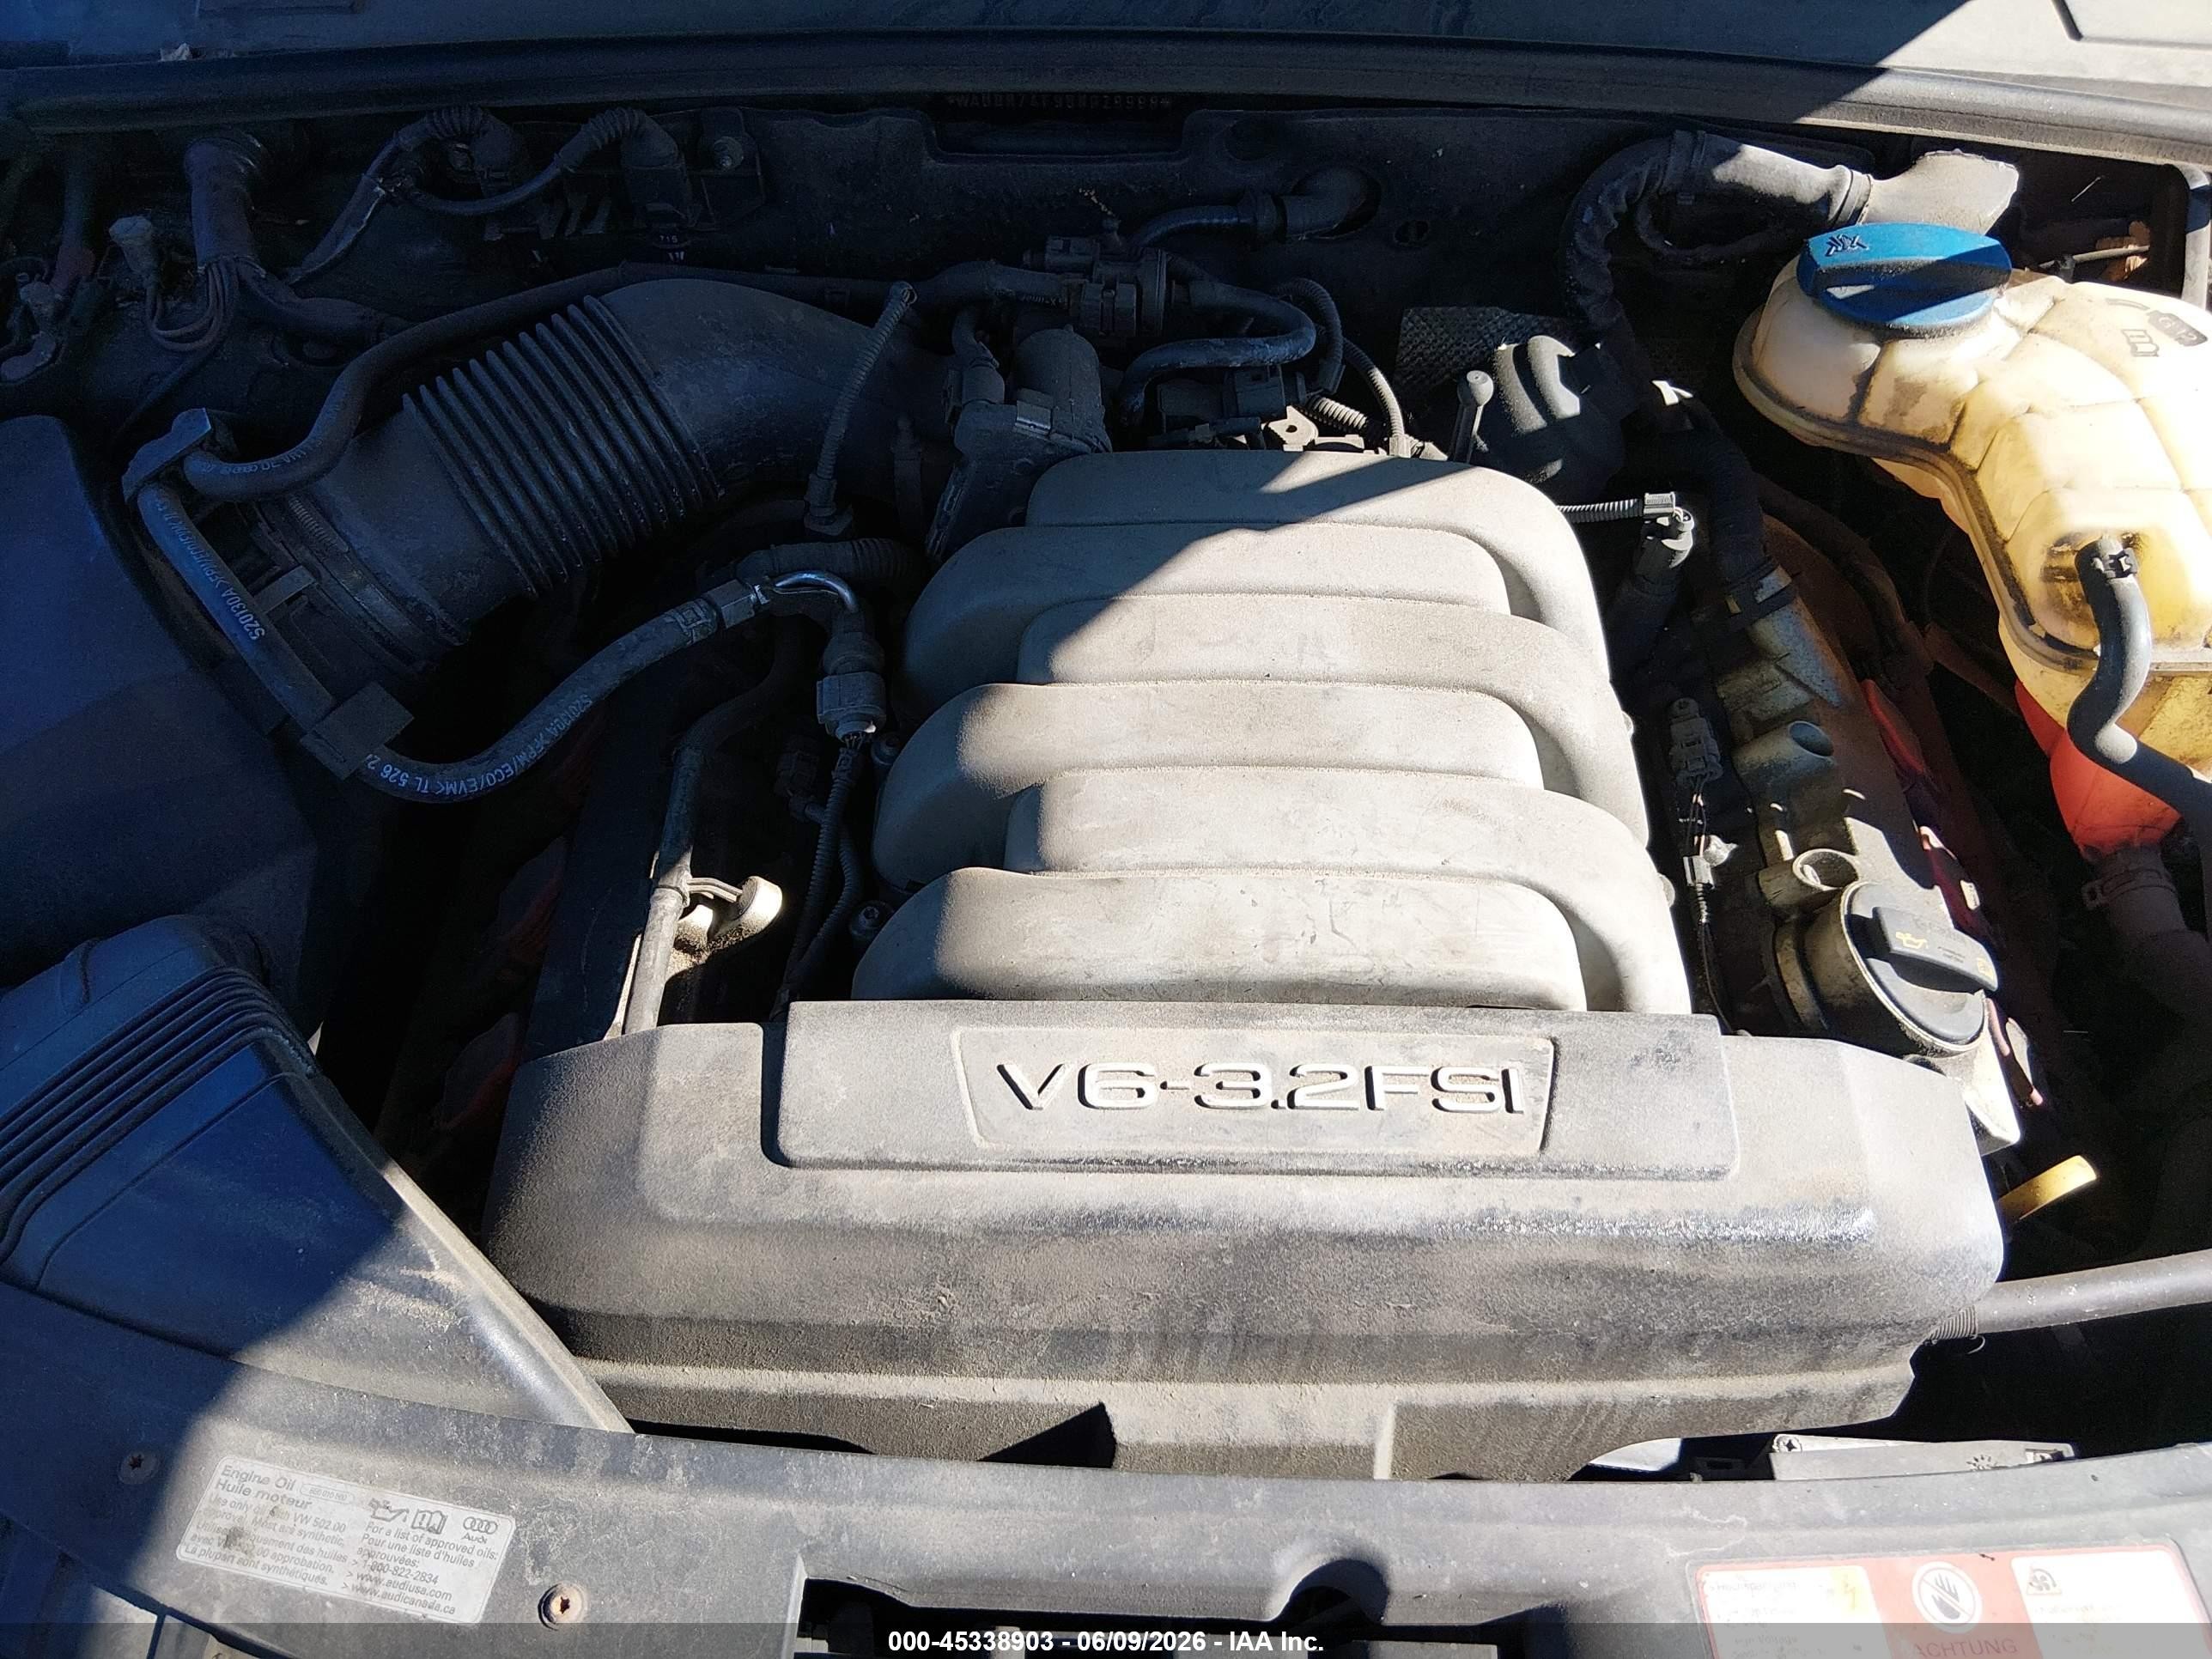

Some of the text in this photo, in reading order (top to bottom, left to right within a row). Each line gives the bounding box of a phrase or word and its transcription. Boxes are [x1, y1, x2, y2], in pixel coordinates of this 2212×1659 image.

[222, 587, 265, 641] S20130A
[380, 763, 410, 787] 526
[415, 775, 430, 793] TL
[221, 1465, 270, 1486] Engine
[274, 1476, 296, 1491] Oil
[216, 1479, 313, 1510] Huile moteur
[210, 1492, 228, 1506] Use
[229, 1498, 253, 1512] only
[294, 1511, 313, 1524] VW
[313, 1516, 347, 1533] 502.00
[190, 1534, 214, 1546] avec
[270, 1551, 335, 1574] approbation.
[197, 1522, 234, 1538] Utilise
[296, 1542, 316, 1555] des
[316, 1547, 349, 1563] huiles
[362, 1534, 475, 1568] Pour une liste d'huiles
[365, 1522, 384, 1535] For
[393, 1528, 411, 1541] list
[412, 1534, 425, 1543] of
[424, 1537, 476, 1557] approved
[477, 1546, 500, 1560] oils:
[461, 1533, 488, 1544] Audi
[185, 1543, 328, 1586] La plupart sont synthétiques.
[362, 1559, 439, 1585] 1-800-822-2834
[350, 1583, 457, 1615] www.audicanada.ca
[356, 1572, 453, 1601] www.audiusa.com
